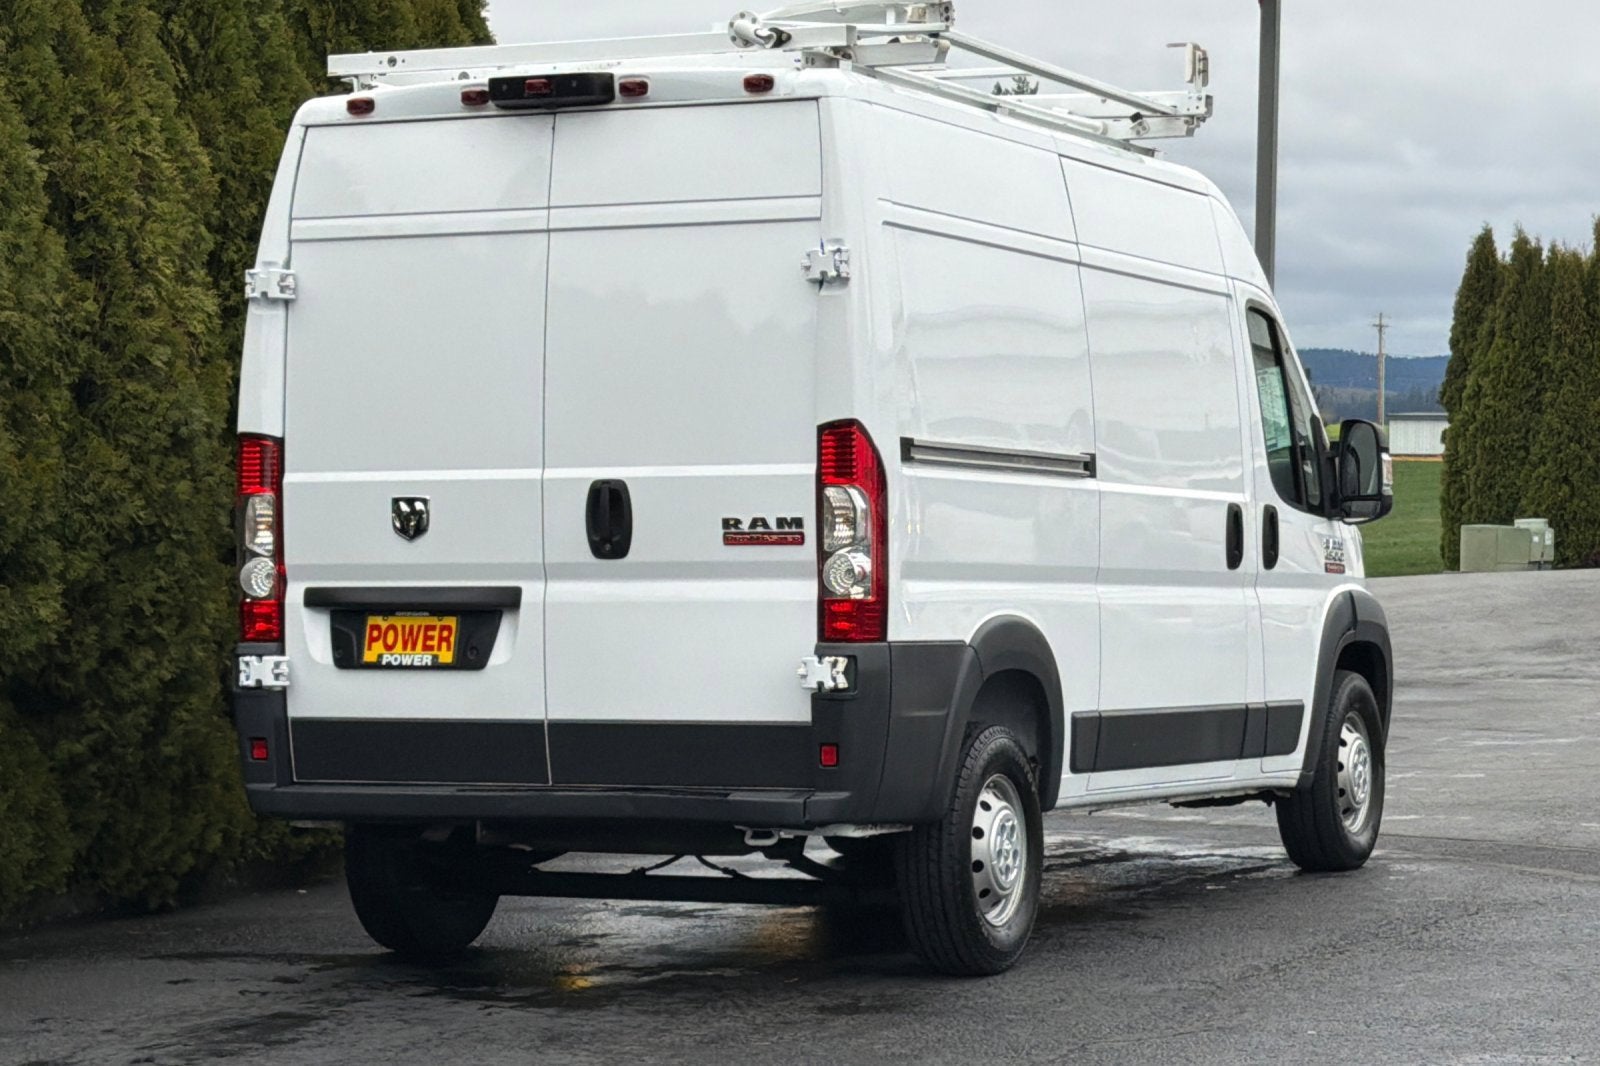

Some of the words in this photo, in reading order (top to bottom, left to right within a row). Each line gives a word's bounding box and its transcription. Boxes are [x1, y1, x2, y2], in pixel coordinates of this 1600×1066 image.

[722, 516, 804, 531] RAM
[366, 623, 453, 652] POWER
[381, 654, 433, 666] POWER
